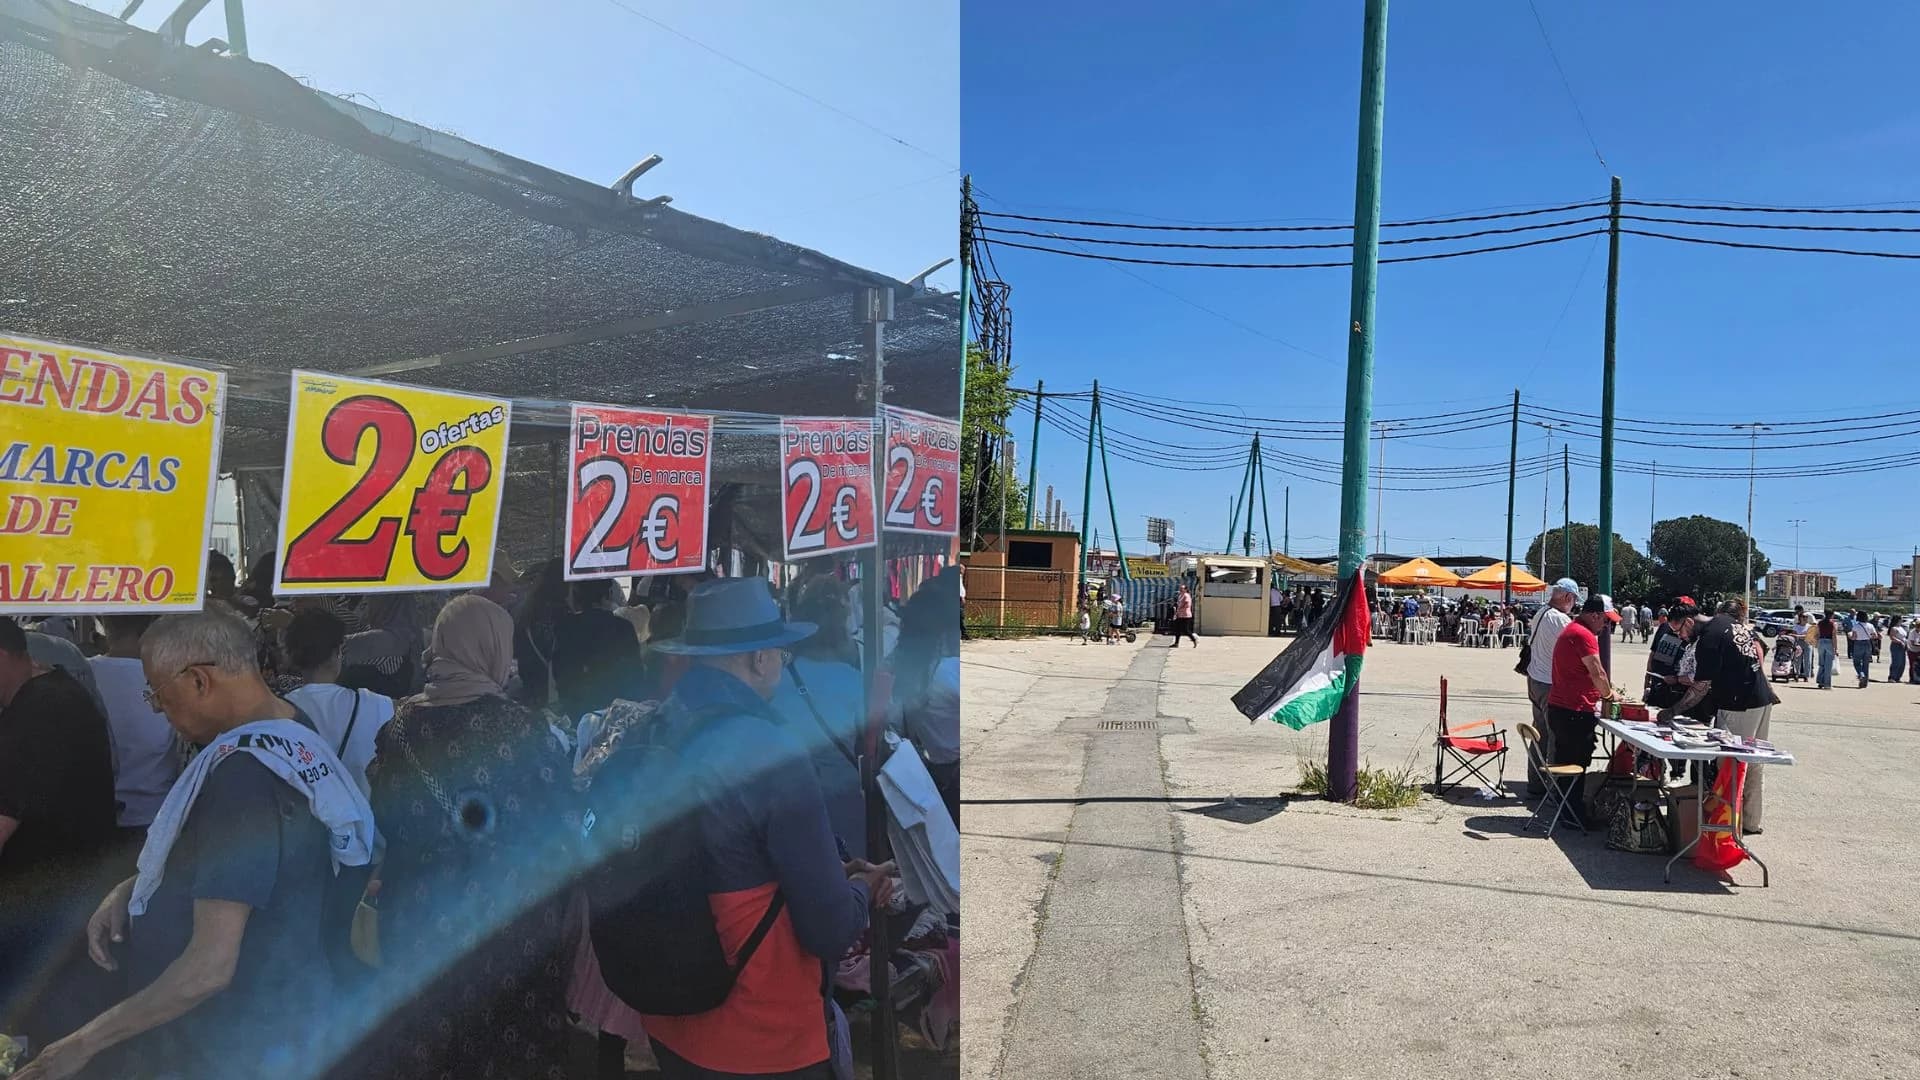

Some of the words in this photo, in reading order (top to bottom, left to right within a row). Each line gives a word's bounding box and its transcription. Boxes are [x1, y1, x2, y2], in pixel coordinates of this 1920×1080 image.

[420, 406, 505, 454] Ofertas
[576, 415, 705, 458] Prendas
[785, 424, 870, 456] Prendas
[889, 416, 959, 452] Prendas
[632, 466, 652, 484] De
[656, 471, 703, 485] marca
[822, 464, 836, 478] De
[1, 495, 78, 535] DE
